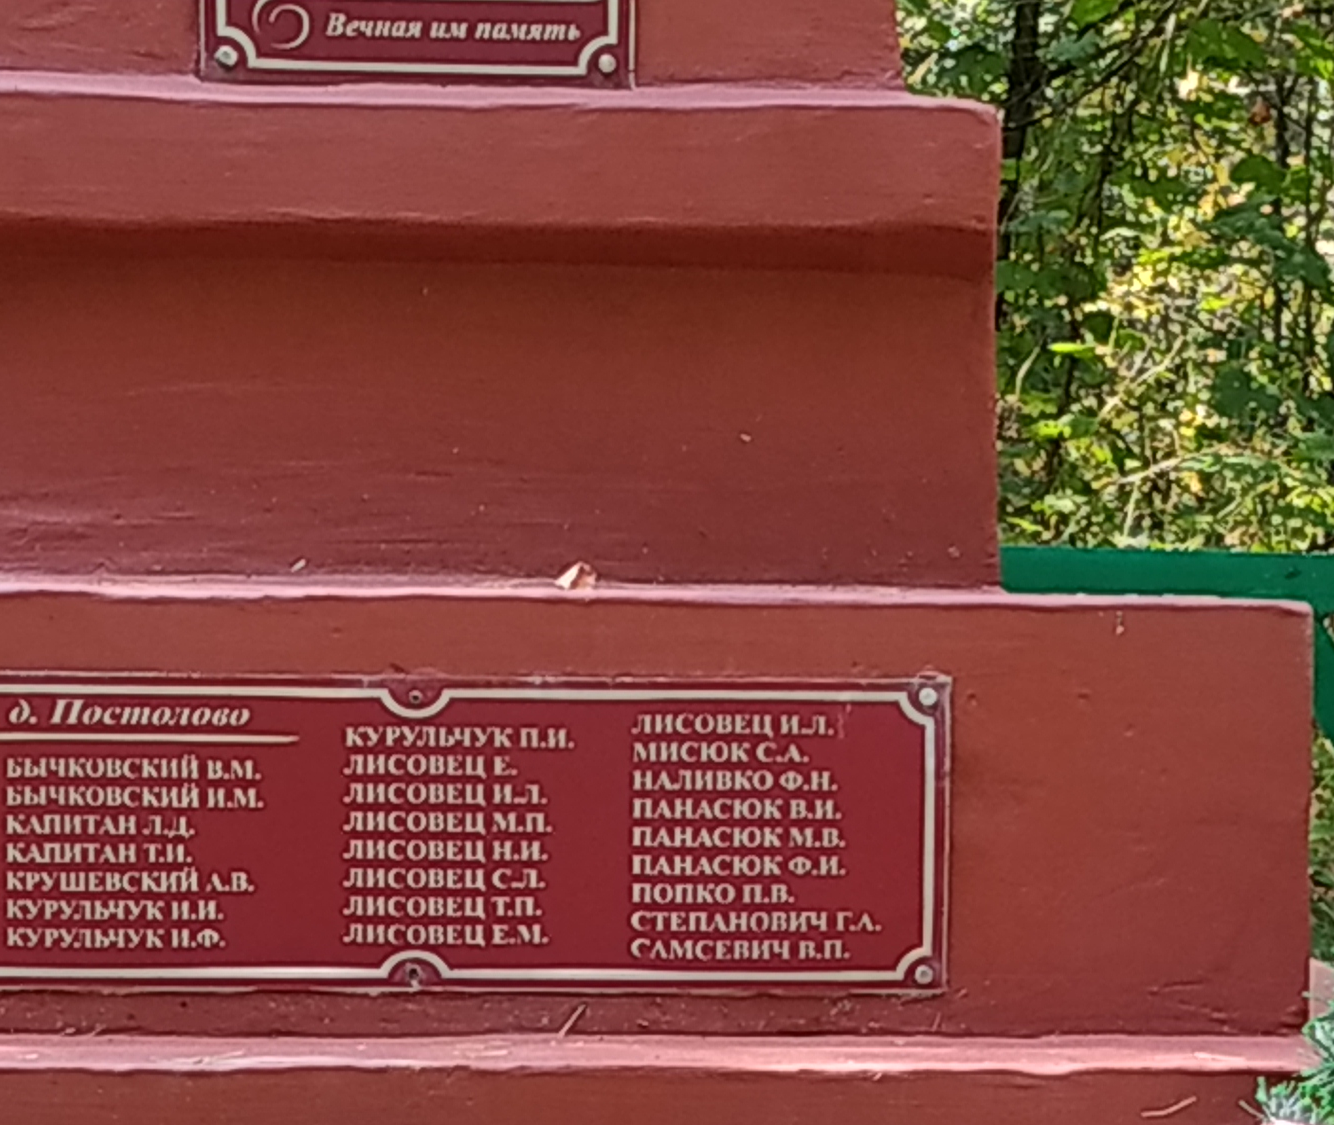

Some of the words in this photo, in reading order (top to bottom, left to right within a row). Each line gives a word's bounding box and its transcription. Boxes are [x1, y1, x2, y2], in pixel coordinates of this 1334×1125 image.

[326, 13, 422, 40] Вечная
[430, 20, 467, 40] им
[475, 20, 580, 42] память
[8, 699, 38, 726] д.
[51, 699, 252, 728] Постолово
[346, 725, 513, 748] КУРУЛЬЧУК
[520, 727, 575, 749] П.И.
[631, 714, 774, 738] ЛИСОВЕЦ
[780, 714, 834, 735] И.Л.
[633, 741, 751, 763] МИСЮК
[755, 741, 809, 763] С.А.
[6, 754, 199, 780] БЫЧКОВСКИЙ
[207, 759, 262, 780] В.М.
[343, 754, 487, 779] ЛИСОВЕЦ
[493, 756, 518, 776] Е.
[633, 769, 774, 791] НАЛИВКО
[779, 770, 838, 791] Ф.Н.
[6, 782, 200, 808] БЫЧКОВСКИЙ
[207, 787, 264, 808] И.М.
[343, 782, 486, 807] ЛИСОВЕЦ
[493, 784, 548, 804] И.Л.
[632, 798, 783, 820] ПАНАСЮК
[790, 799, 842, 820] В.И.
[6, 814, 137, 835] КАПИТАН
[142, 815, 195, 838] Л.Д.
[343, 811, 486, 835] ЛИСОВЕЦ
[492, 812, 552, 833] М.П.
[632, 826, 783, 848] ПАНАСЮК
[789, 827, 846, 848] М.В.
[6, 842, 137, 864] КАПИТАН
[143, 843, 192, 863] Т.И.
[342, 839, 486, 863] ЛИСОВЕЦ
[492, 840, 548, 861] Н.И.
[632, 854, 783, 876] ПАНАСЮК
[788, 856, 846, 876] Ф.И.
[6, 867, 199, 893] КРУШЕВСКИЙ
[206, 871, 254, 892] А.В.
[342, 867, 486, 892] ЛИСОВЕЦ
[491, 868, 546, 889] С.Л.
[632, 882, 736, 904] ПОПКО
[742, 884, 795, 904] П.В.
[6, 898, 165, 921] КУРУЛЬЧУК
[171, 899, 224, 920] И.И.
[342, 896, 486, 920] ЛИСОВЕЦ
[491, 896, 542, 917] Т.П.
[630, 910, 827, 932] СТЕПАНОВИЧ
[836, 911, 882, 931] Г.А.
[7, 927, 165, 948] КУРУЛЬЧУК
[171, 928, 226, 948] И.Ф.
[343, 923, 486, 947] ЛИСОВЕЦ
[492, 924, 549, 945] Е.М.
[630, 938, 790, 960] САМСЕВИЧ
[799, 939, 850, 959] В.П.
